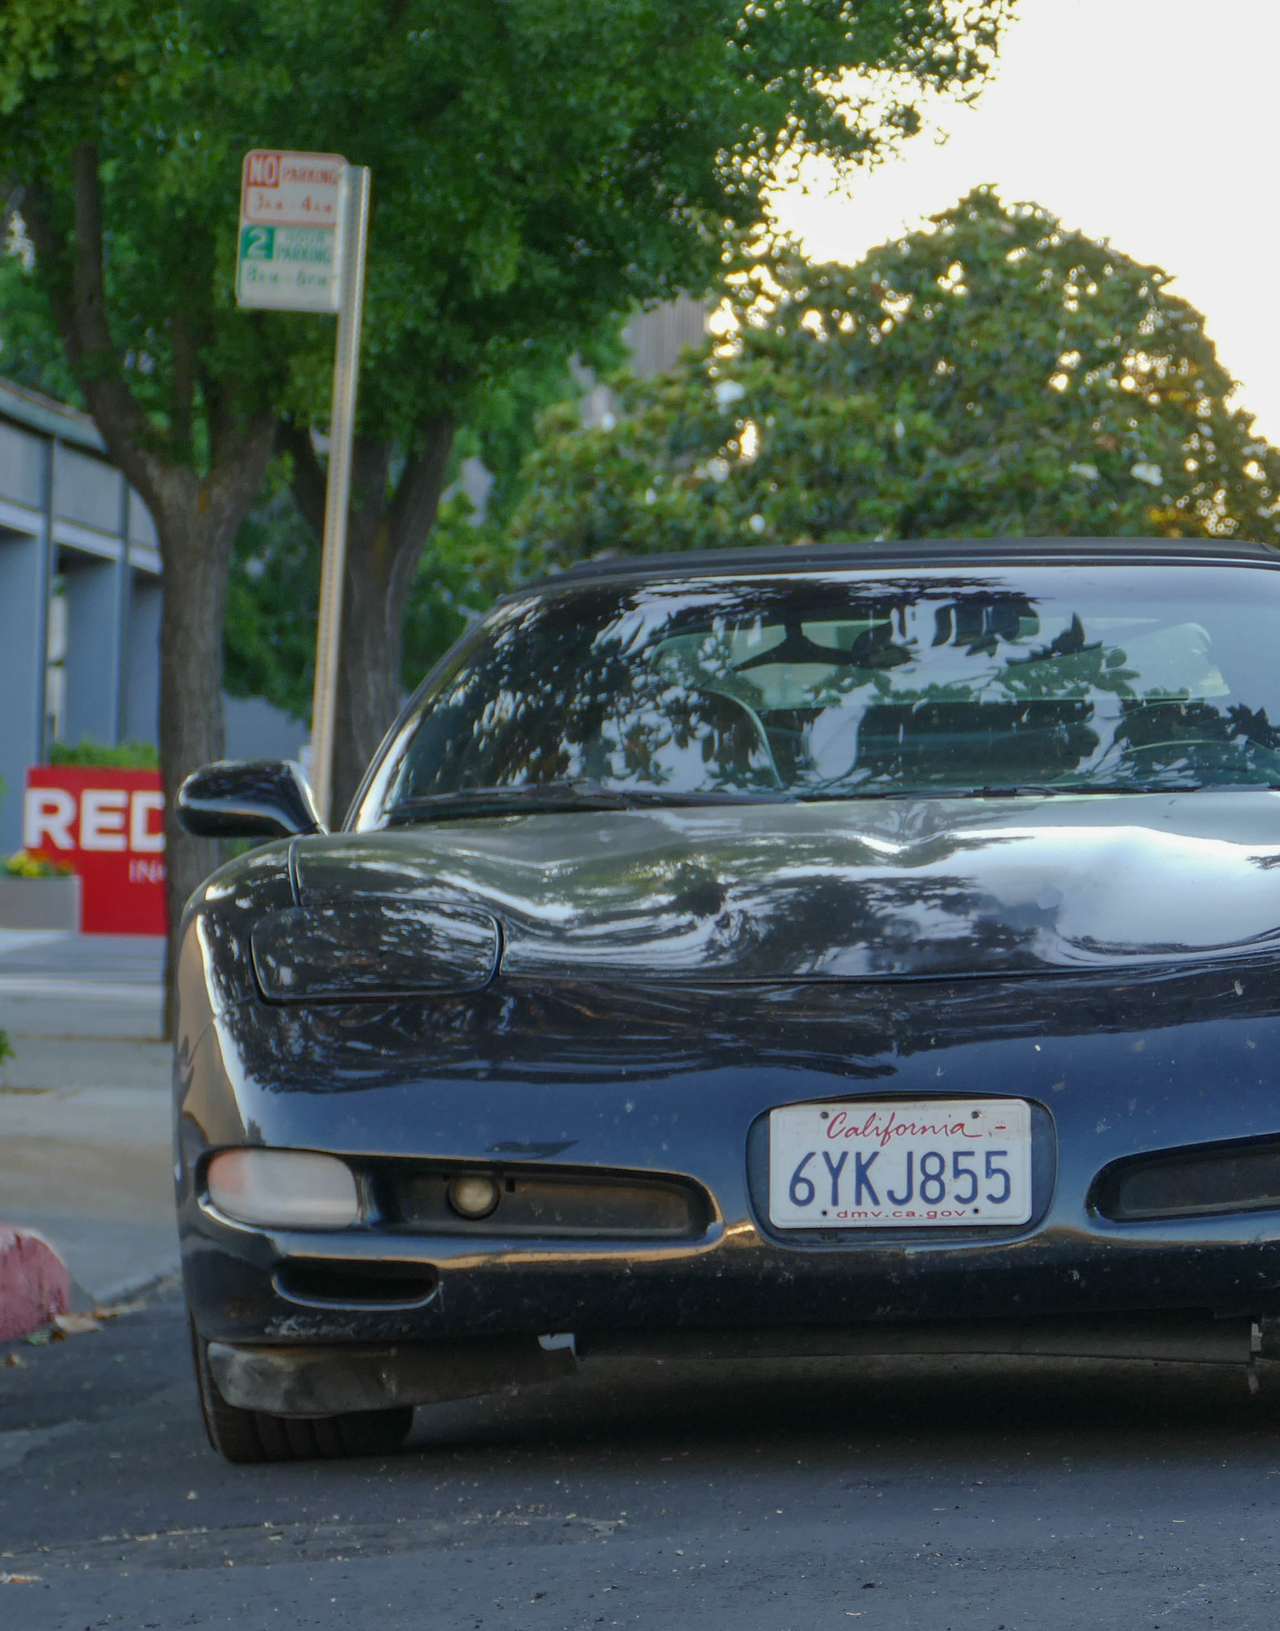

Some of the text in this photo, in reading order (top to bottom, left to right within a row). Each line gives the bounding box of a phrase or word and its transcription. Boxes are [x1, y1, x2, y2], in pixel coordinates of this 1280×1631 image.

[250, 156, 341, 187] NO PARKING
[247, 228, 269, 258] 2
[275, 245, 333, 265] PARKING
[826, 1112, 983, 1147] California
[788, 1151, 1012, 1207] 6YKJ855
[836, 1209, 967, 1220] dmv.ca.gov
